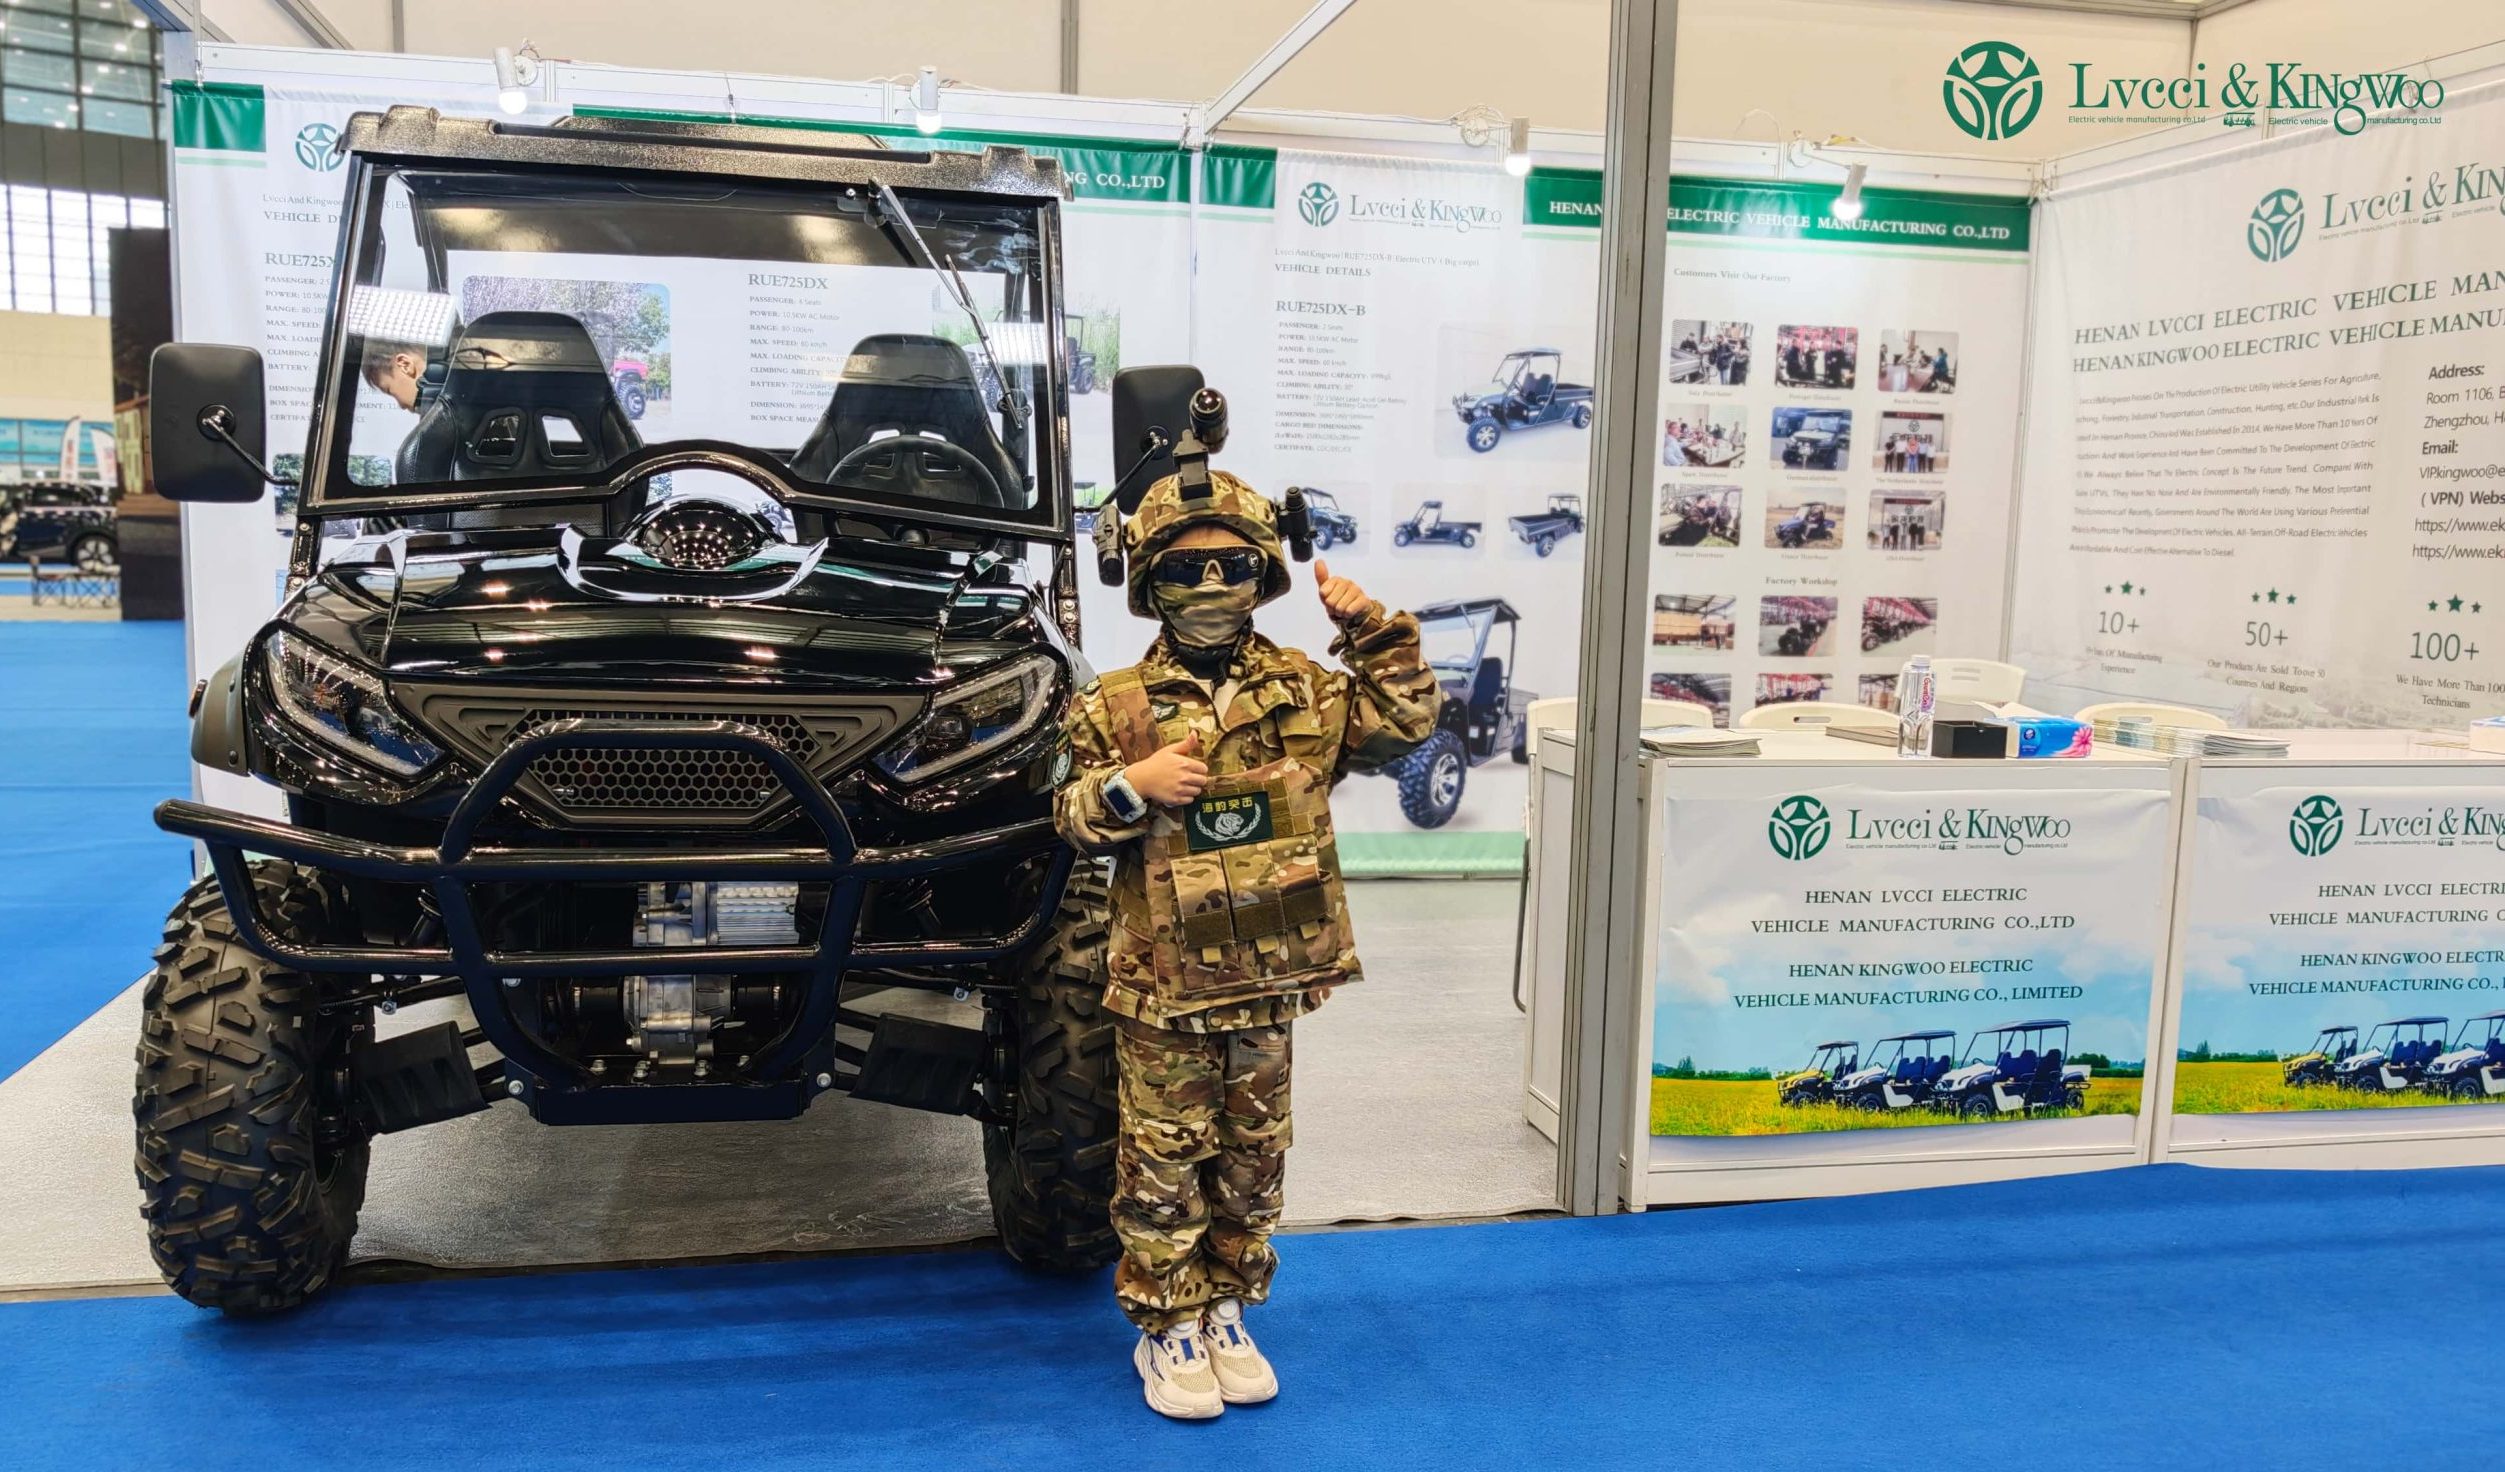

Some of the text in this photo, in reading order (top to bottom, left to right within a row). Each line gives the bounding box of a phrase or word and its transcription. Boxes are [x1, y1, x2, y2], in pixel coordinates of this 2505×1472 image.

[1096, 173, 1165, 190] CO.,LTD
[2320, 162, 2505, 230] Lvcci & KIN
[264, 211, 321, 223] VEHICLE
[1411, 199, 1427, 220] &
[1549, 200, 2010, 240] HENAN ELECTRIC VEHICLE MANUFACTURING CO.,LTD
[1274, 262, 1371, 277] VEHICLE DETAILS
[1674, 268, 1717, 279] Customers
[265, 275, 317, 285] PASSENGER:
[748, 273, 829, 290] RUE725DX
[265, 290, 300, 299] POWER:
[750, 295, 796, 305] PASSENGER:
[265, 304, 299, 313] RANGE:
[750, 310, 780, 318] POWER:
[1276, 300, 1366, 317] RUE725DX-B
[2074, 322, 2141, 345] HENAN
[2147, 313, 2205, 337] LVCCI
[2213, 297, 2318, 328] ELECTRIC
[2333, 280, 2437, 311] VEHICLE
[266, 319, 321, 329] MAX. SPEED:
[267, 334, 287, 342] MAX.
[2073, 308, 2505, 373] HENAN KINGWOO ELECTRIC VEHICLE MANU
[267, 348, 310, 357] CLIMBING
[2428, 364, 2485, 380] Address:
[2426, 387, 2495, 405] Room 1106,
[2423, 411, 2505, 431] Zhengzhou, H
[2421, 440, 2459, 455] Email:
[1765, 576, 1838, 587] Factory Workshop
[2097, 610, 2140, 635] 10+
[2245, 621, 2288, 647] 50+
[2410, 631, 2480, 662] 100+
[2207, 659, 2221, 669] Our
[2224, 661, 2253, 673] Products
[2260, 679, 2275, 690] And
[2396, 674, 2409, 685] We
[2411, 675, 2433, 687] Have
[2437, 678, 2460, 690] More
[2464, 680, 2485, 692] Than
[2422, 695, 2470, 709] Technicians
[1845, 808, 1933, 840] Lvcci
[1938, 808, 1961, 839] &
[2355, 807, 2432, 837] Lvcci
[2438, 806, 2460, 836] &
[1805, 887, 2028, 904] HENAN LVCCI ELECTRIC
[2317, 884, 2376, 897] HENAN
[2384, 883, 2432, 897] LVCCI
[1751, 915, 2075, 934] VEHICLE MANUFACTURING CO.,LTD
[2269, 909, 2488, 926] VEHICLE MANUFACTURING
[2300, 954, 2358, 967] HENAN
[2361, 951, 2442, 966] KINGWOO
[1789, 959, 2033, 978] HENAN KINGWOO ELECTRIC
[2249, 976, 2499, 995] VEHICLE MANUFACTURING CO.,
[1734, 985, 2083, 1009] VEHICLE MANUFACTURING CO., LIMITED
